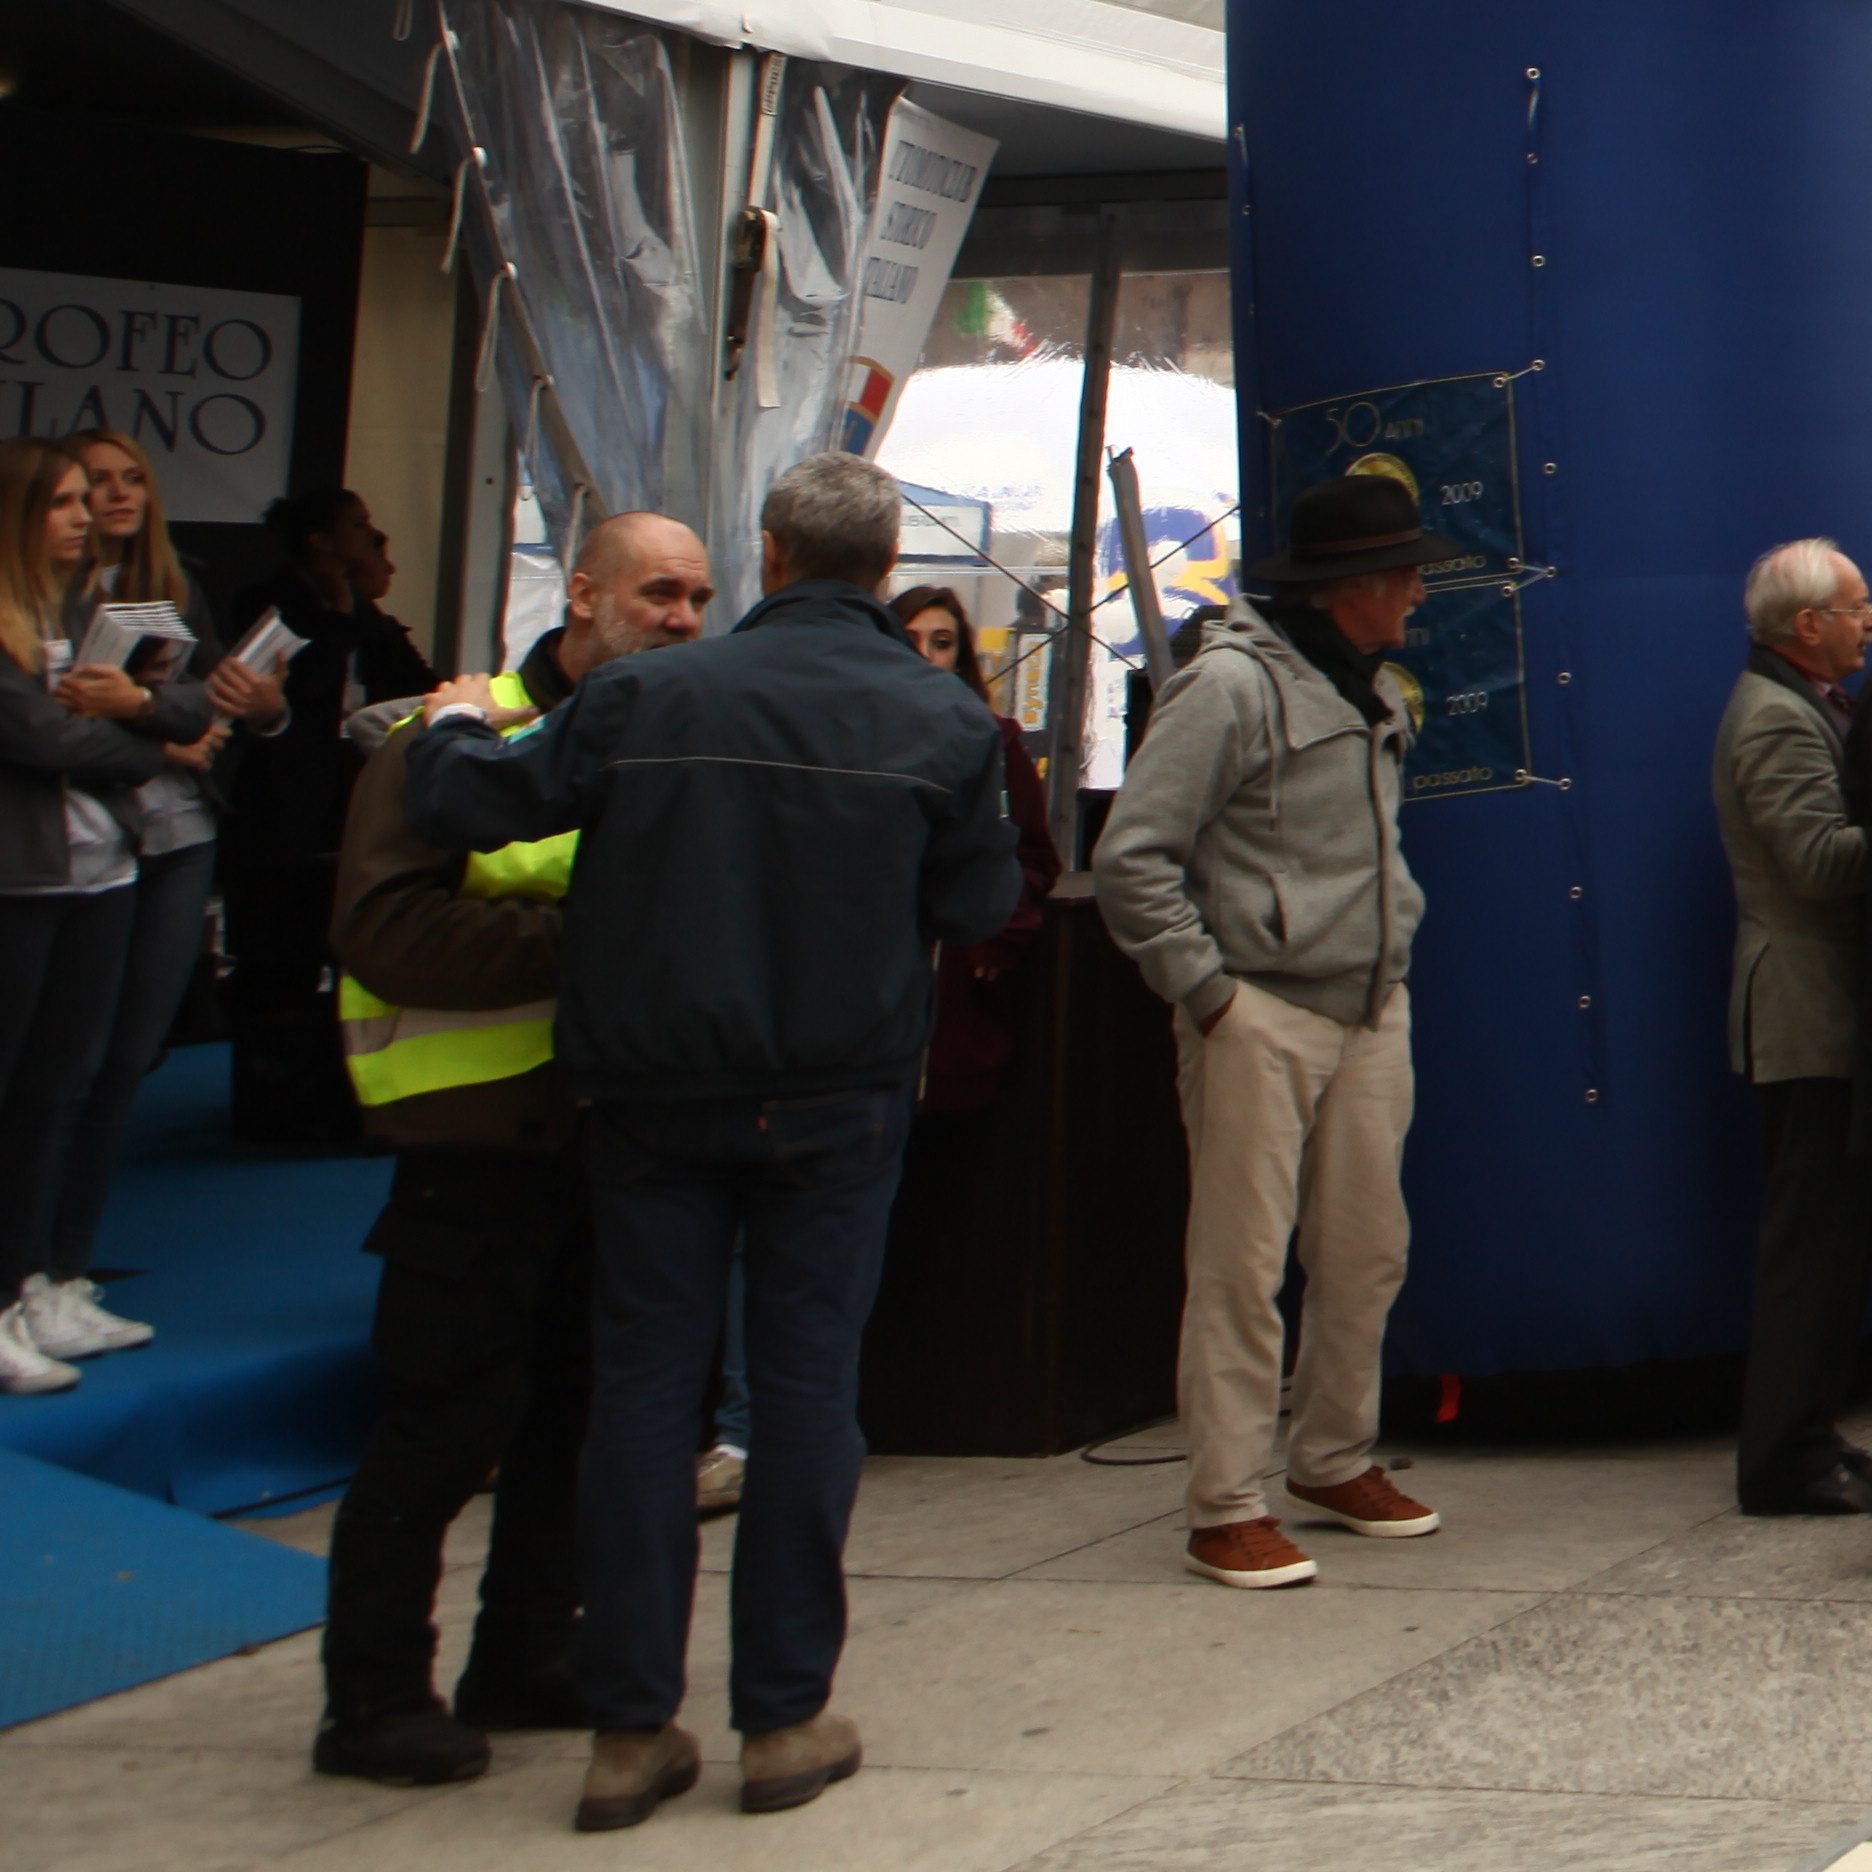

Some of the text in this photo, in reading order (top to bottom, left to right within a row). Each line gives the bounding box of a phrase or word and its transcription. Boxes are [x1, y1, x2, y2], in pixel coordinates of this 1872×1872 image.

[1324, 401, 1382, 454] 50
[1440, 480, 1484, 506] 2009
[1444, 690, 1489, 717] 2009
